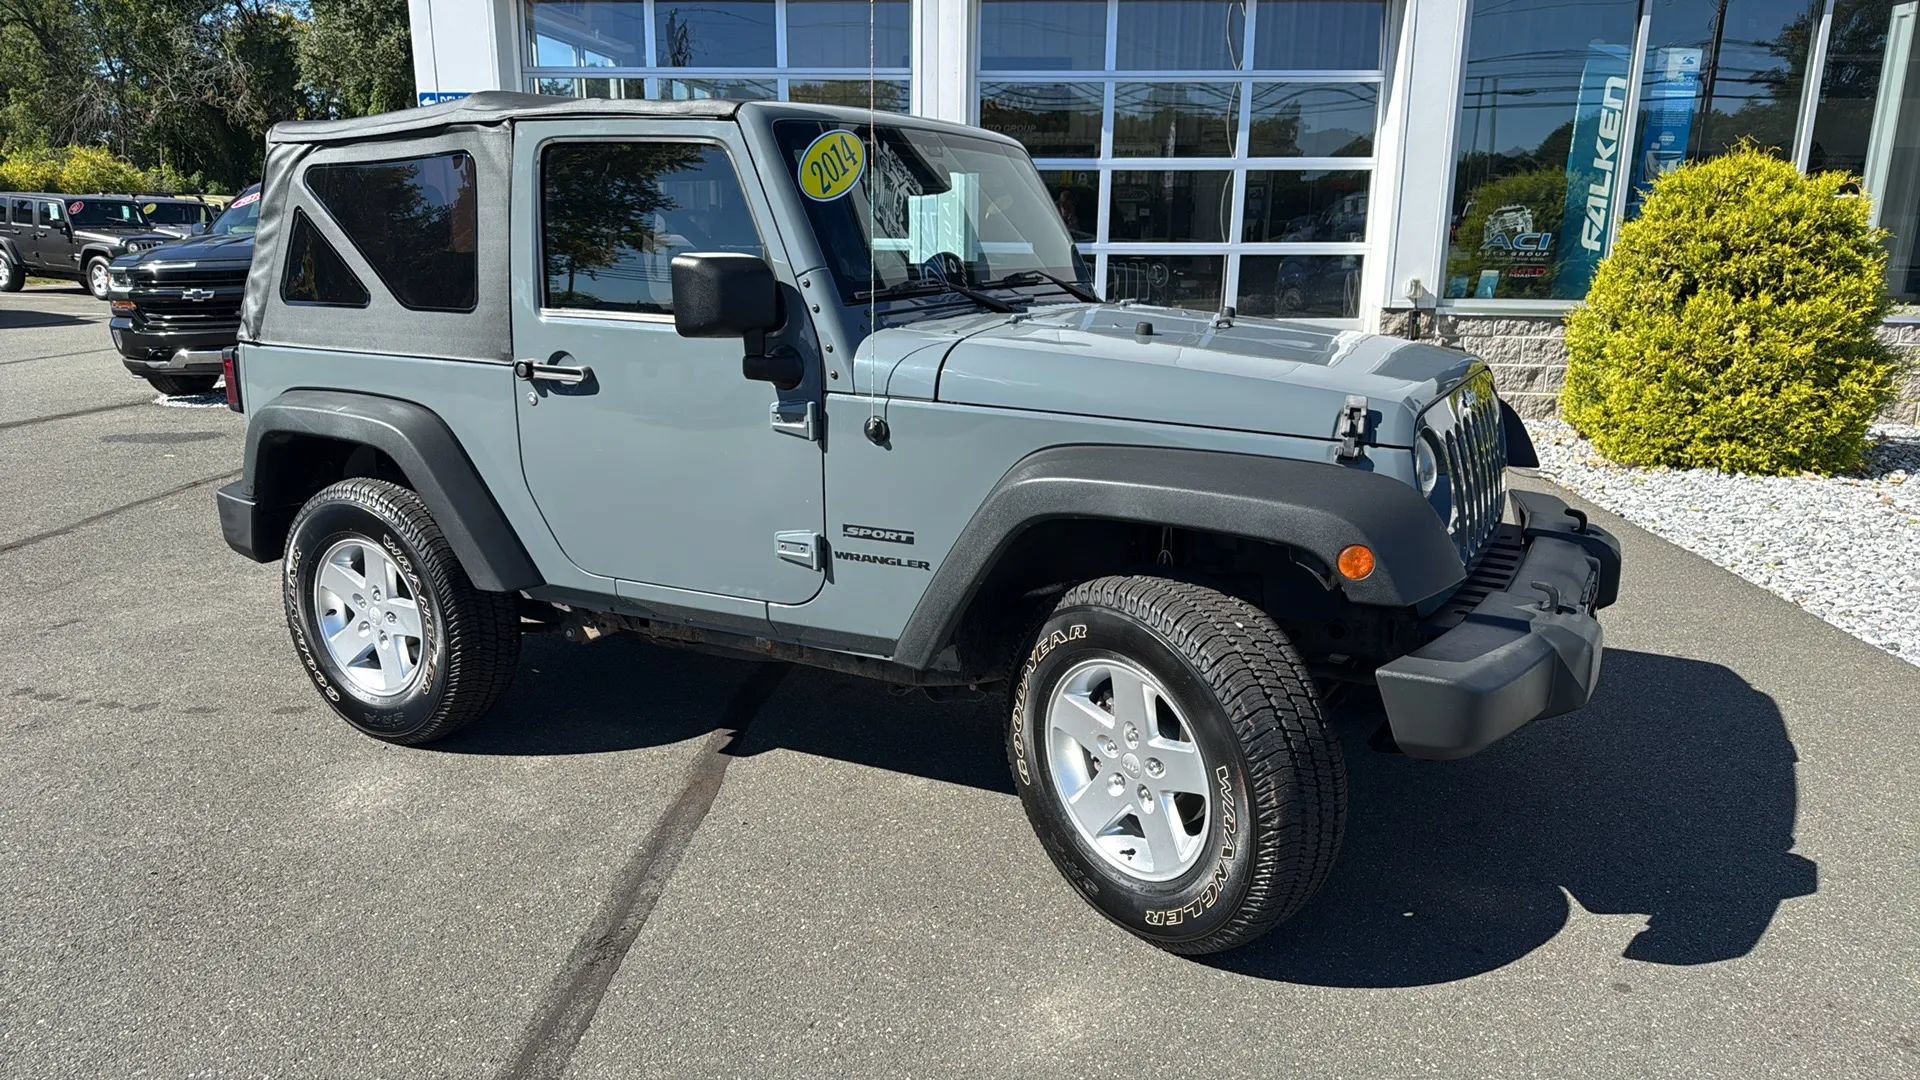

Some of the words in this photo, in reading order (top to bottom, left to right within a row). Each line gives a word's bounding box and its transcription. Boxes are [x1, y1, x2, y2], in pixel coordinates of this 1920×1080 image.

[811, 136, 857, 194] 2014
[1480, 233, 1552, 250] ACI
[1581, 76, 1627, 252] FALKEN
[834, 551, 931, 571] WRANGLER
[845, 526, 914, 543] SPORT
[287, 547, 341, 702] GOODYEAR
[383, 533, 438, 696] WRANGLER
[1011, 624, 1088, 786] GOODYEAR
[1145, 765, 1238, 926] WRANGLER
